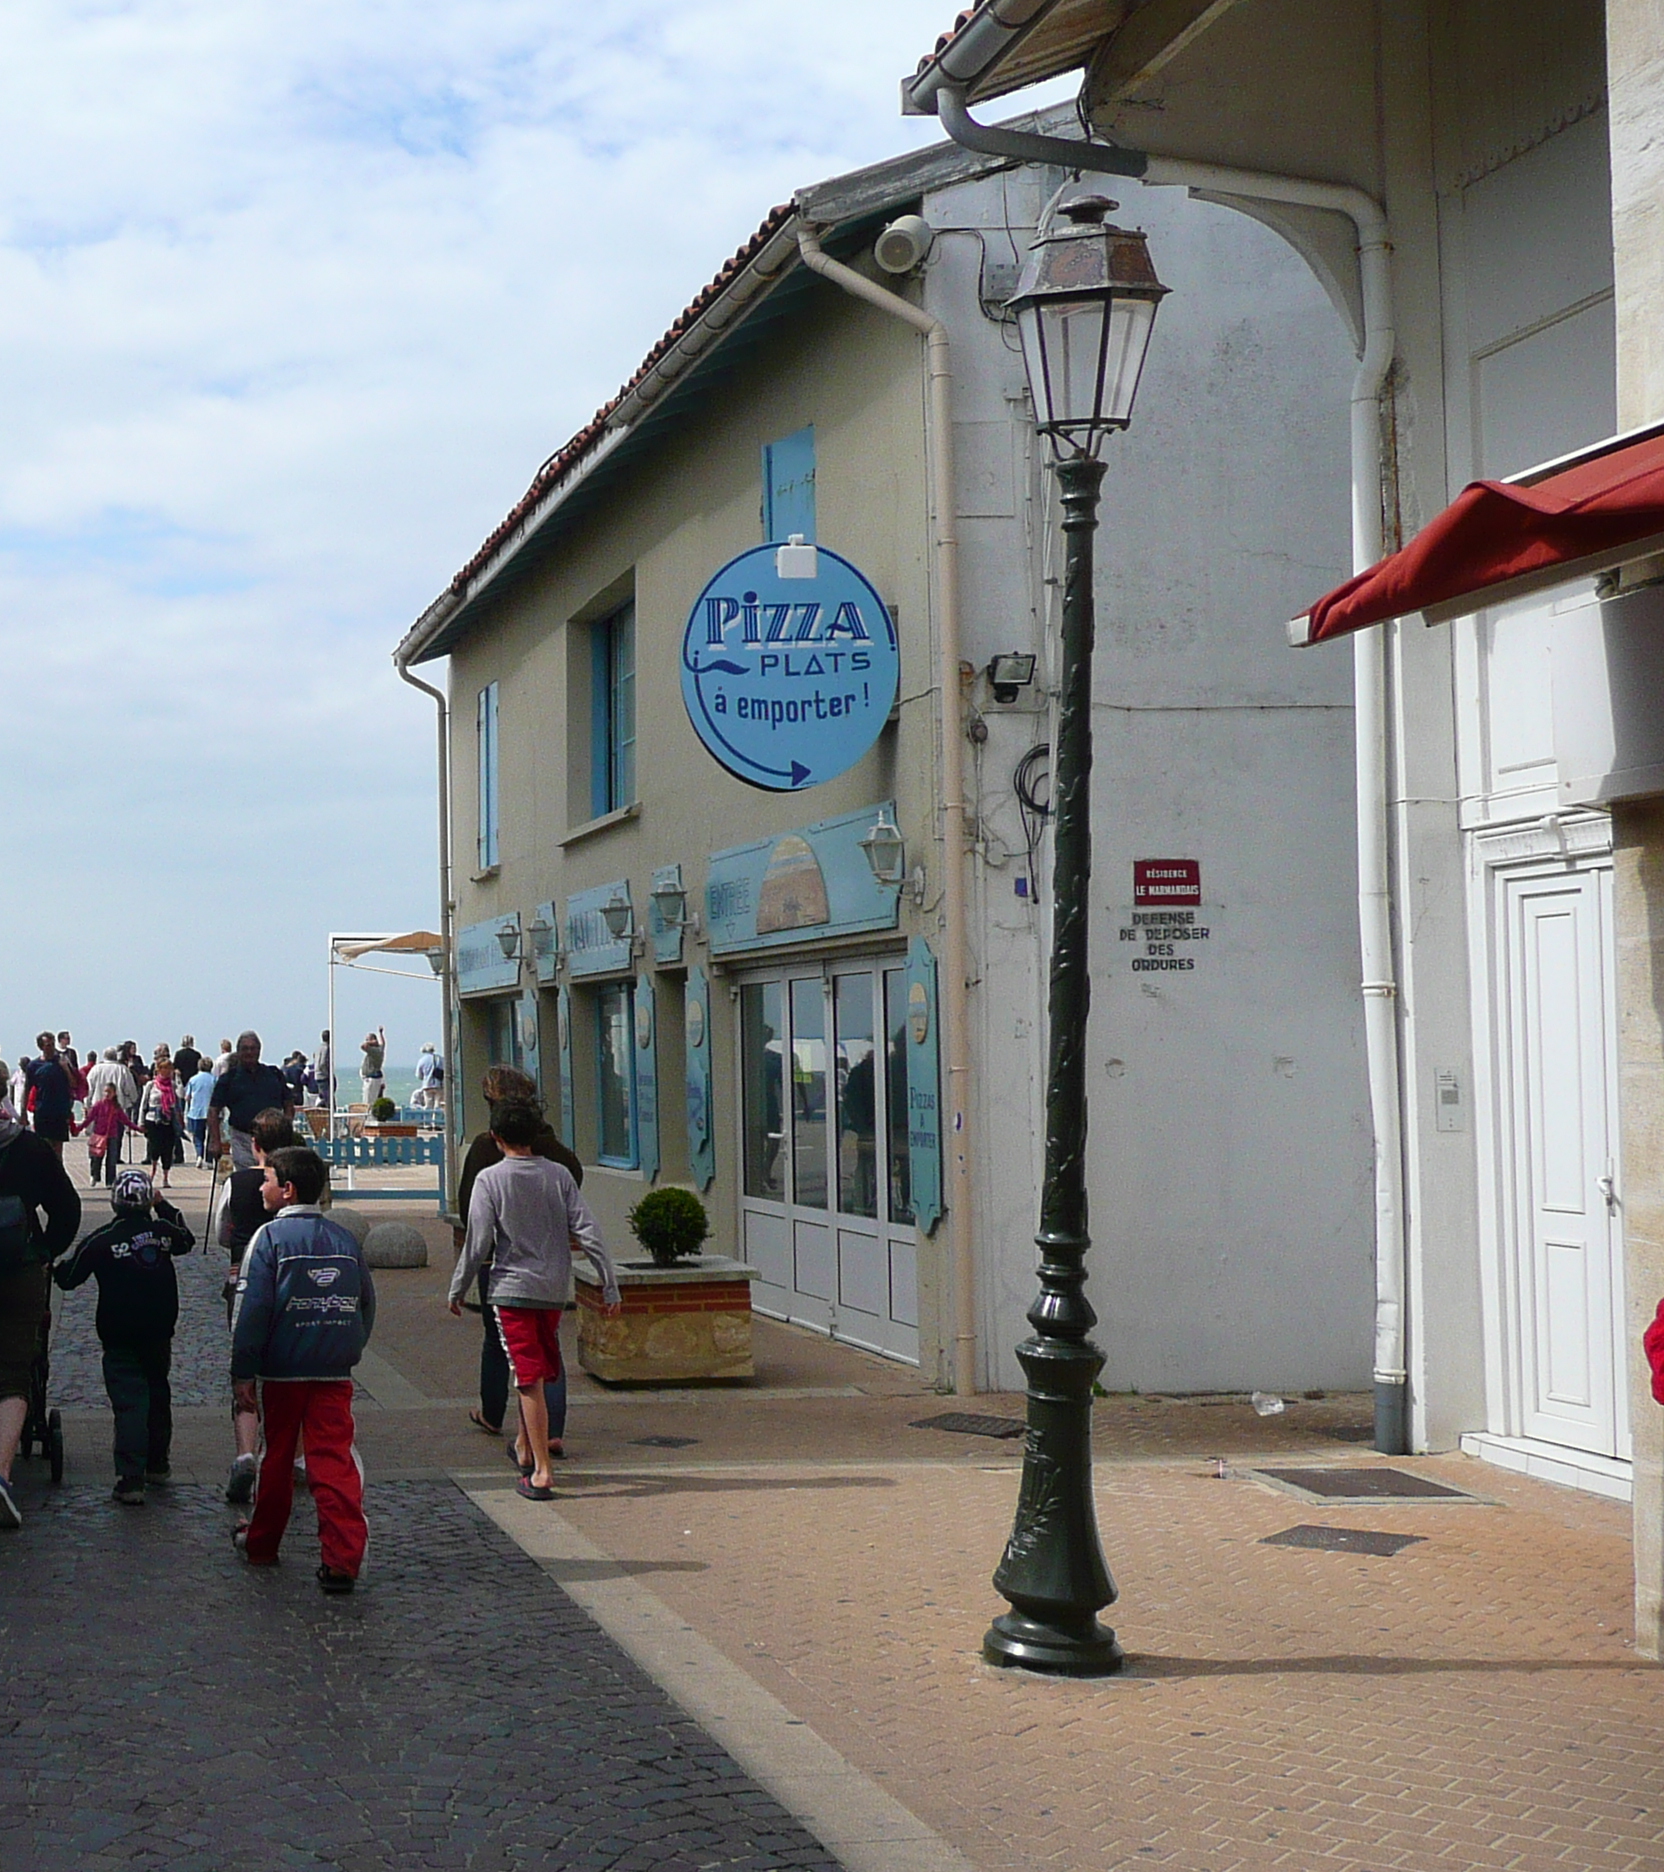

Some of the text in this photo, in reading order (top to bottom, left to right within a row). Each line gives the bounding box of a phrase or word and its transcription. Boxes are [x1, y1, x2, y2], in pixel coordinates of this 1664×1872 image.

[760, 652, 871, 677] PLATS
[737, 690, 856, 731] emporter
[1136, 885, 1146, 896] LE
[1132, 912, 1195, 926] DEFENSE
[1119, 928, 1210, 941] DE DEPOSER
[1148, 944, 1174, 956] DES
[1132, 958, 1195, 971] ORDURES
